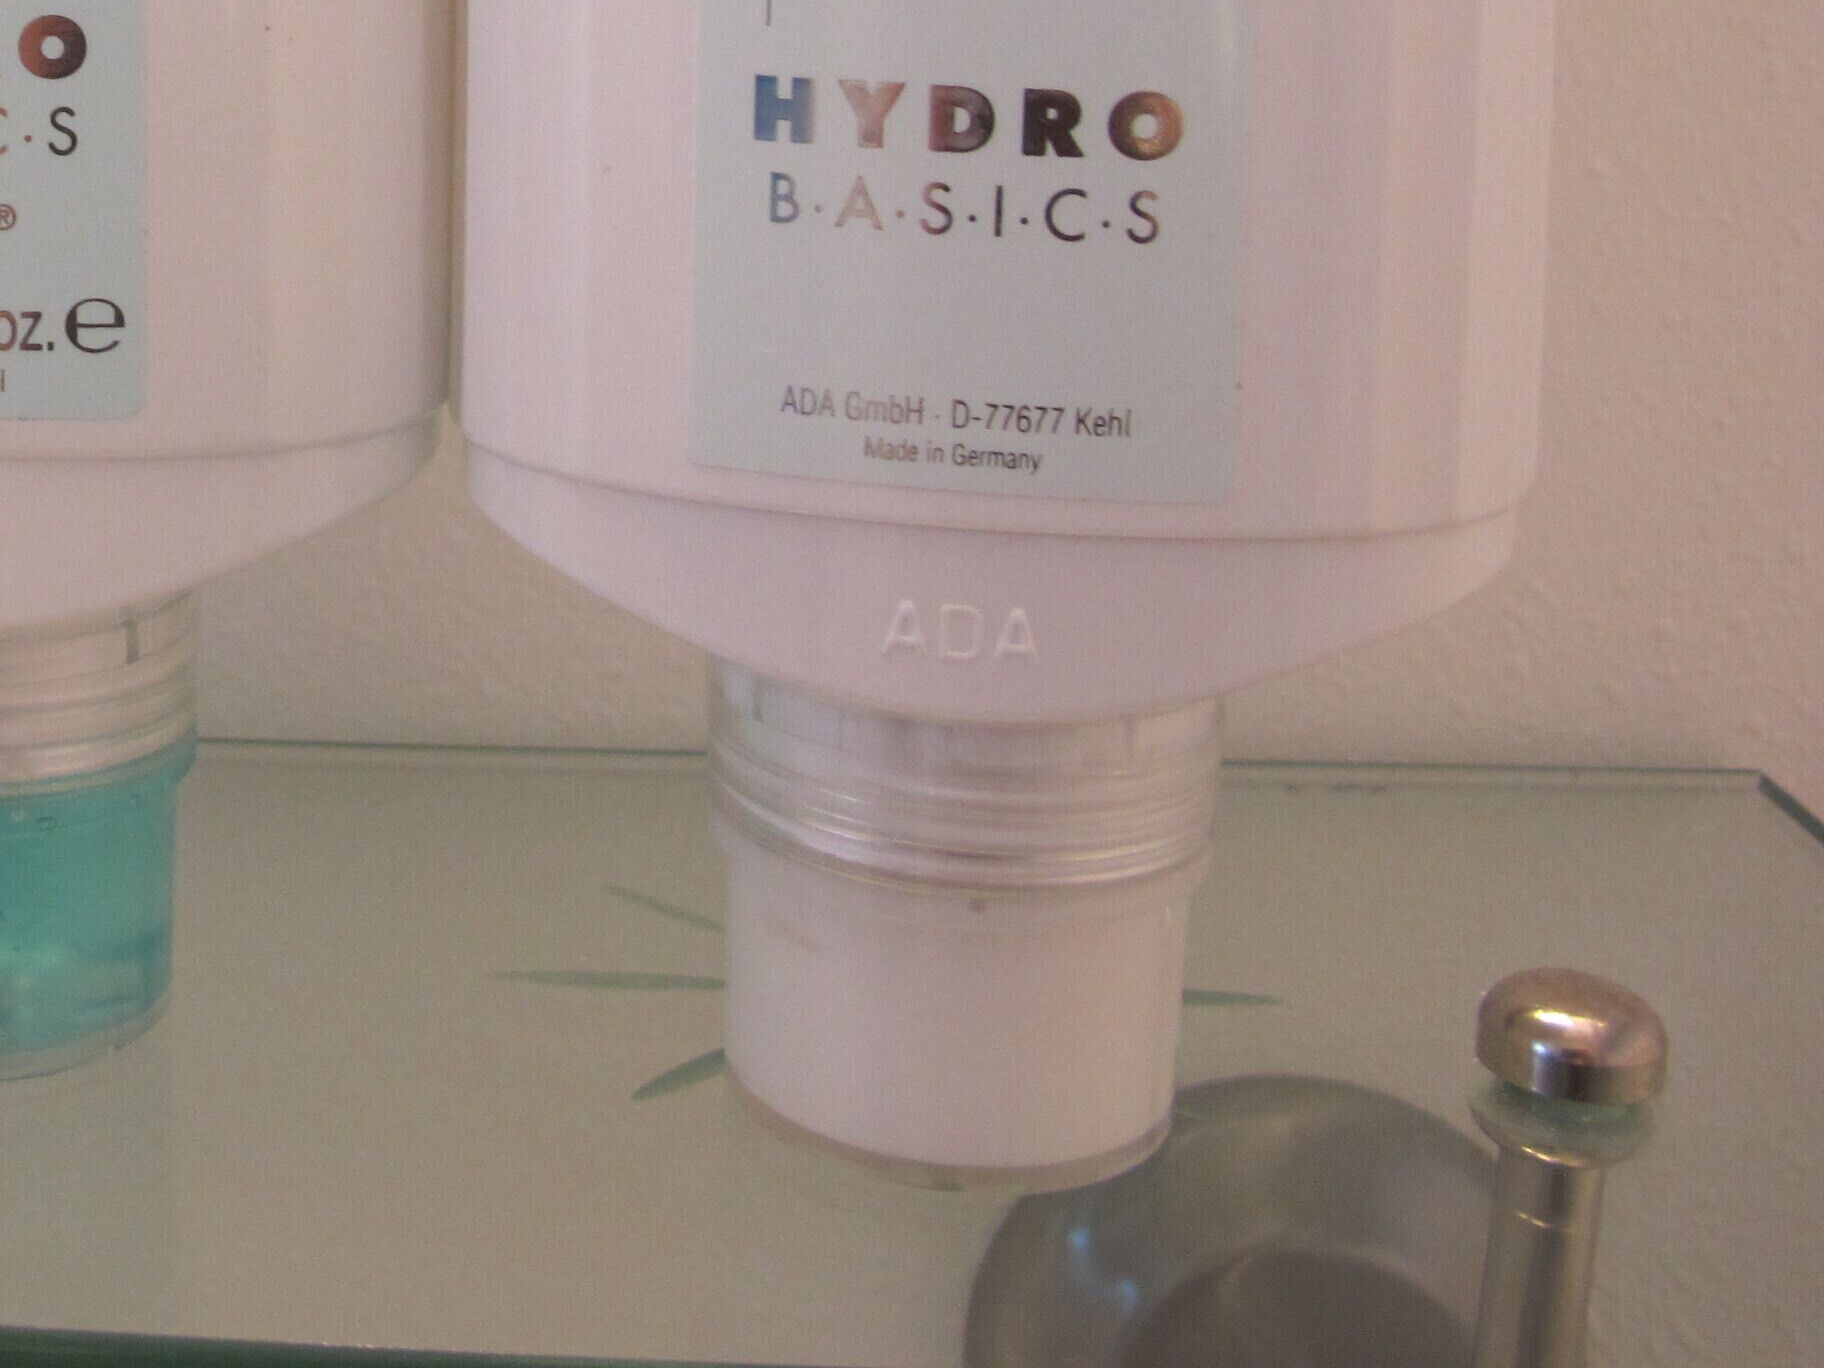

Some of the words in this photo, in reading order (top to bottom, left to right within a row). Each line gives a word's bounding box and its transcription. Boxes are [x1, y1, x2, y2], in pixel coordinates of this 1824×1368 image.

[752, 74, 1184, 160] HYDRO
[780, 385, 835, 417] ADA
[845, 391, 923, 425] GmbH
[952, 399, 1064, 432] D-77677
[1076, 408, 1132, 436] Kehl
[864, 436, 918, 462] Made
[927, 441, 944, 463] in
[952, 444, 1040, 474] Germany
[881, 598, 1040, 664] ADA
